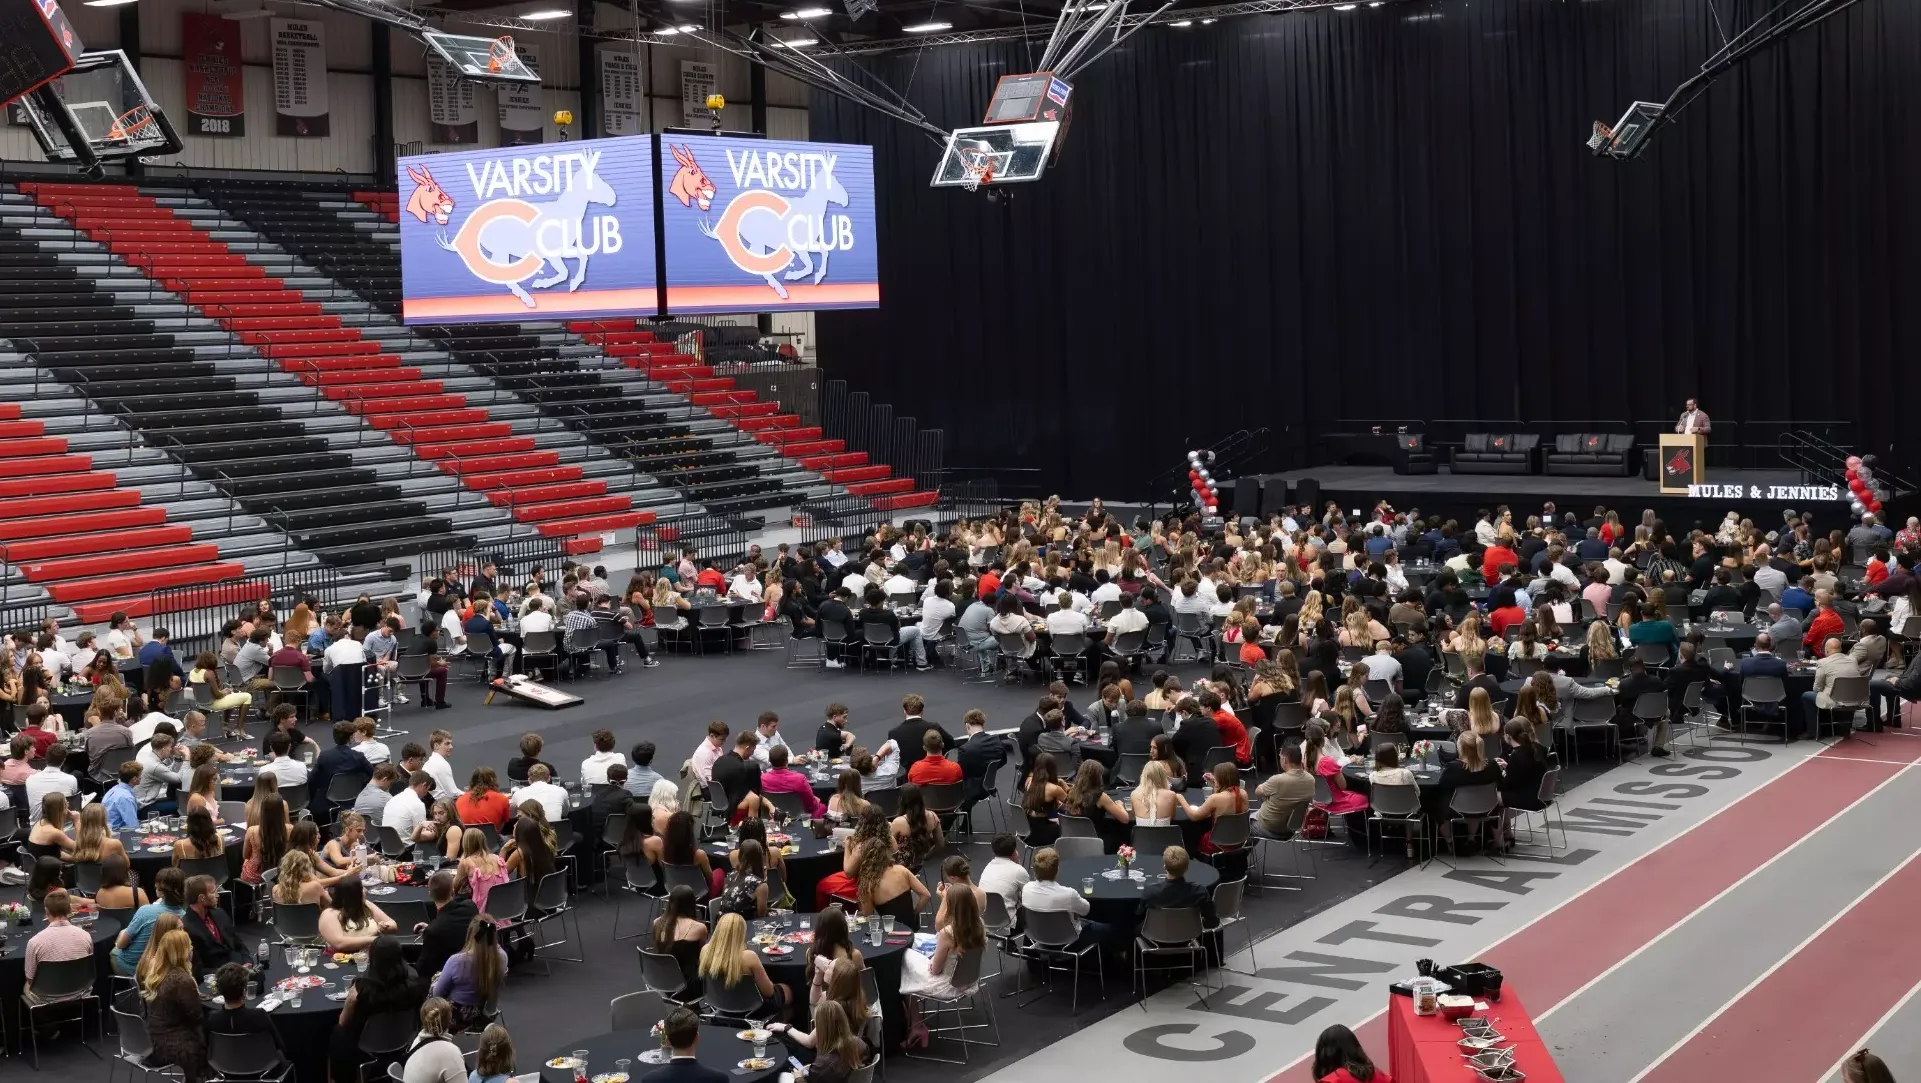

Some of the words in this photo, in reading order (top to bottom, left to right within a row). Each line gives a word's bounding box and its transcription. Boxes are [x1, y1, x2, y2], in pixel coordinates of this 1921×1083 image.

[201, 118, 231, 134] 2018
[466, 151, 601, 199] VARSITY
[725, 149, 837, 190] VARSITY
[536, 215, 623, 258] CLUB
[787, 213, 854, 251] CLUB
[1687, 483, 1743, 498] MULES
[1750, 486, 1762, 499] &
[1767, 485, 1838, 501] JENNIES
[1123, 848, 1601, 1062] CENTRAL
